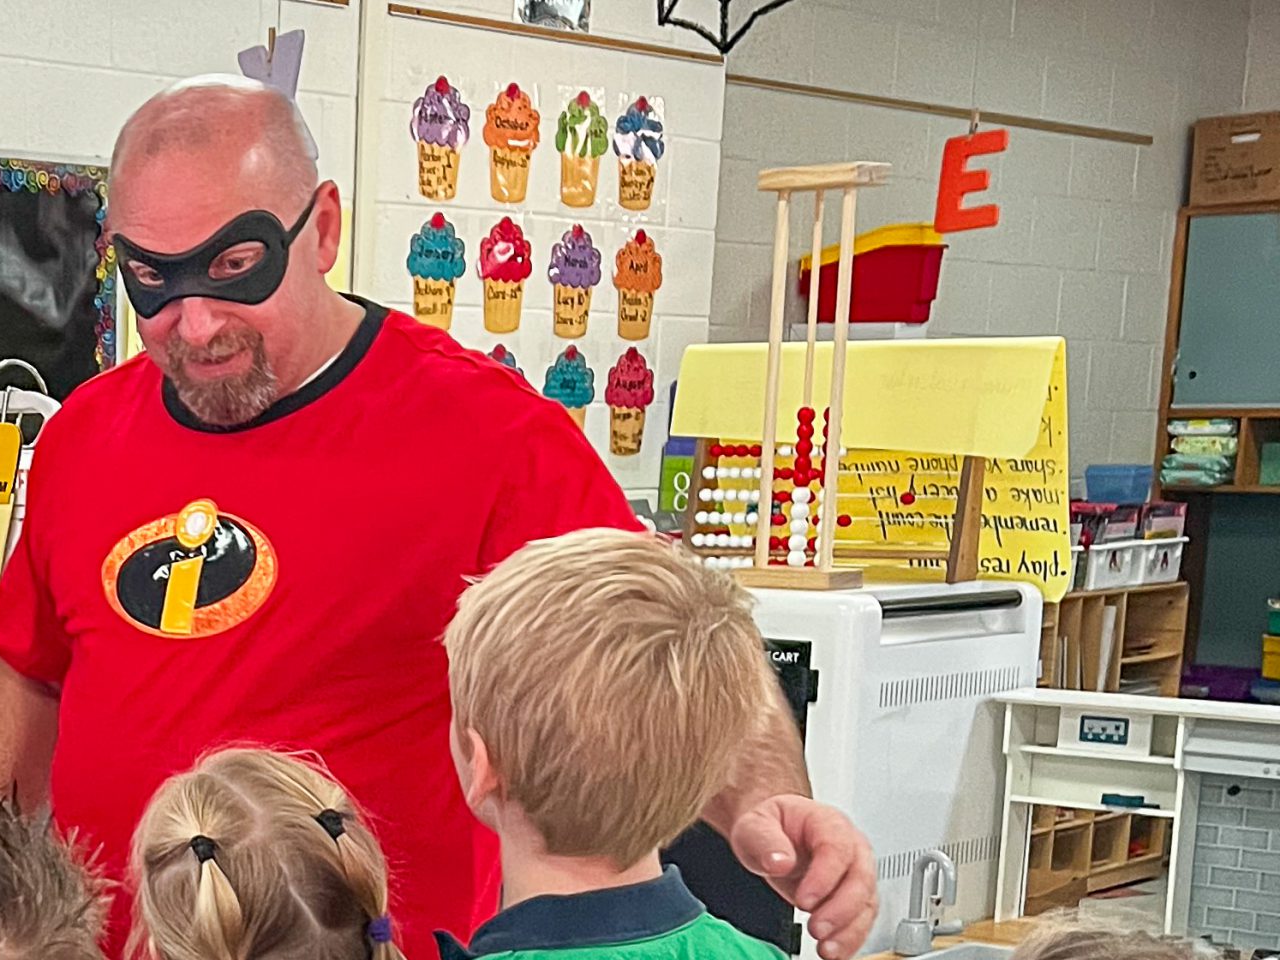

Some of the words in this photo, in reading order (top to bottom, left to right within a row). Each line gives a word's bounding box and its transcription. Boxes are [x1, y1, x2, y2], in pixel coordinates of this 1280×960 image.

[494, 116, 529, 130] October
[934, 129, 1008, 233] E
[628, 259, 648, 274] April
[673, 471, 691, 512] 8
[772, 651, 800, 664] CART
